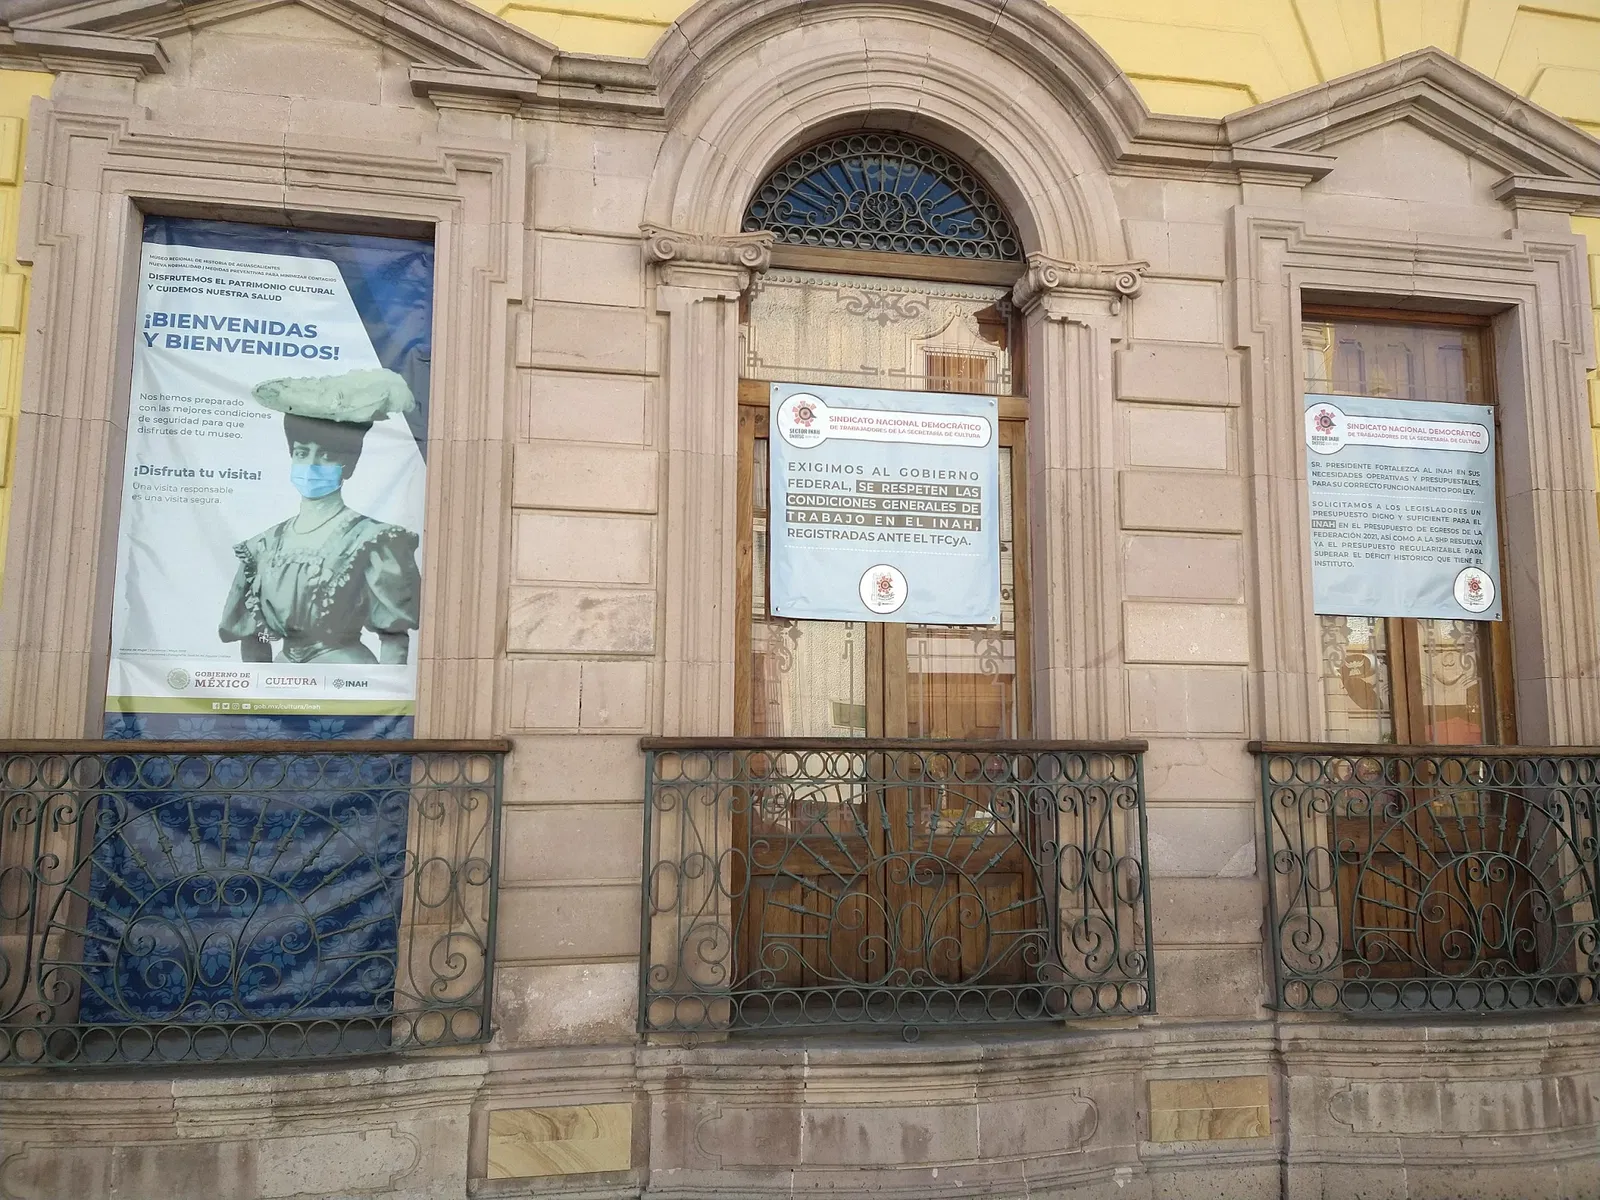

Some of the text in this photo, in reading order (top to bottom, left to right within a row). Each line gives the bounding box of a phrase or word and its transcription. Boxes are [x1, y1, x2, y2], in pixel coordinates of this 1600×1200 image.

[236, 262, 280, 270] AGUASCALIENTES
[149, 273, 212, 283] DISFRUTEMOS
[229, 280, 286, 291] PATRIMONIO
[289, 285, 335, 295] CULTURAL
[156, 285, 203, 294] CUIDEMOS
[207, 289, 249, 298] NUESTRA
[251, 293, 282, 301] SALUD
[144, 312, 317, 338] ¡BIENVENIDAS
[143, 332, 339, 360] Y BIENVENIDOS!
[160, 393, 192, 402] hemos
[195, 396, 244, 406] preparado
[173, 406, 212, 415] mejores
[214, 409, 271, 419] condiciones
[153, 416, 199, 425] seguridad
[829, 416, 981, 431] SINDICATO NACIONAL DEMOCRÁTICO
[138, 426, 178, 435] disfrutes
[208, 430, 242, 439] museo.
[840, 426, 887, 434] TRABAJADORES
[1347, 423, 1387, 431] SINDICATO
[1389, 426, 1427, 434] NACIONAL
[134, 465, 261, 480] ¡Disfruta tu visita!
[788, 462, 979, 481] EXIGIMOS AL GOBIERNO
[1375, 464, 1419, 472] FORTALEZCA
[1312, 471, 1362, 479] NECESIDADES
[1367, 473, 1409, 481] OPERATIVAS
[133, 482, 233, 494] Una visita responsable
[788, 479, 979, 497] FEDERAL, SE RESPETEN LAS
[1383, 483, 1447, 492] FUNCIONAMIENTO
[190, 497, 221, 505] segura.
[787, 495, 978, 513] CONDICIONES GENERALES DE
[1312, 501, 1372, 509] SOLICITAMOS
[1405, 505, 1468, 515] LEGISLADORES
[787, 511, 979, 531] TRABAJO EN EL INAH,
[1407, 515, 1449, 523] SUFICIENTE
[1313, 520, 1335, 528] INAH
[1364, 523, 1413, 532] PRESUPUESTO
[788, 528, 971, 547] REGISTRADAS ANTE EL TFCyA.
[1313, 531, 1362, 539] FEDERACIÓN
[1363, 532, 1380, 541] 2021,
[1381, 533, 1391, 541] ASÍ
[1450, 538, 1482, 546] RESUELVA
[1341, 542, 1396, 550] PRESUPUESTO
[1400, 545, 1461, 553] REGULARIZABLE
[1314, 550, 1348, 558] SUPERAR
[1394, 553, 1433, 562] HISTÓRICO
[1314, 560, 1355, 568] INSTITUTO.
[195, 677, 249, 688] MÉXICO
[265, 677, 317, 686] CULTURA
